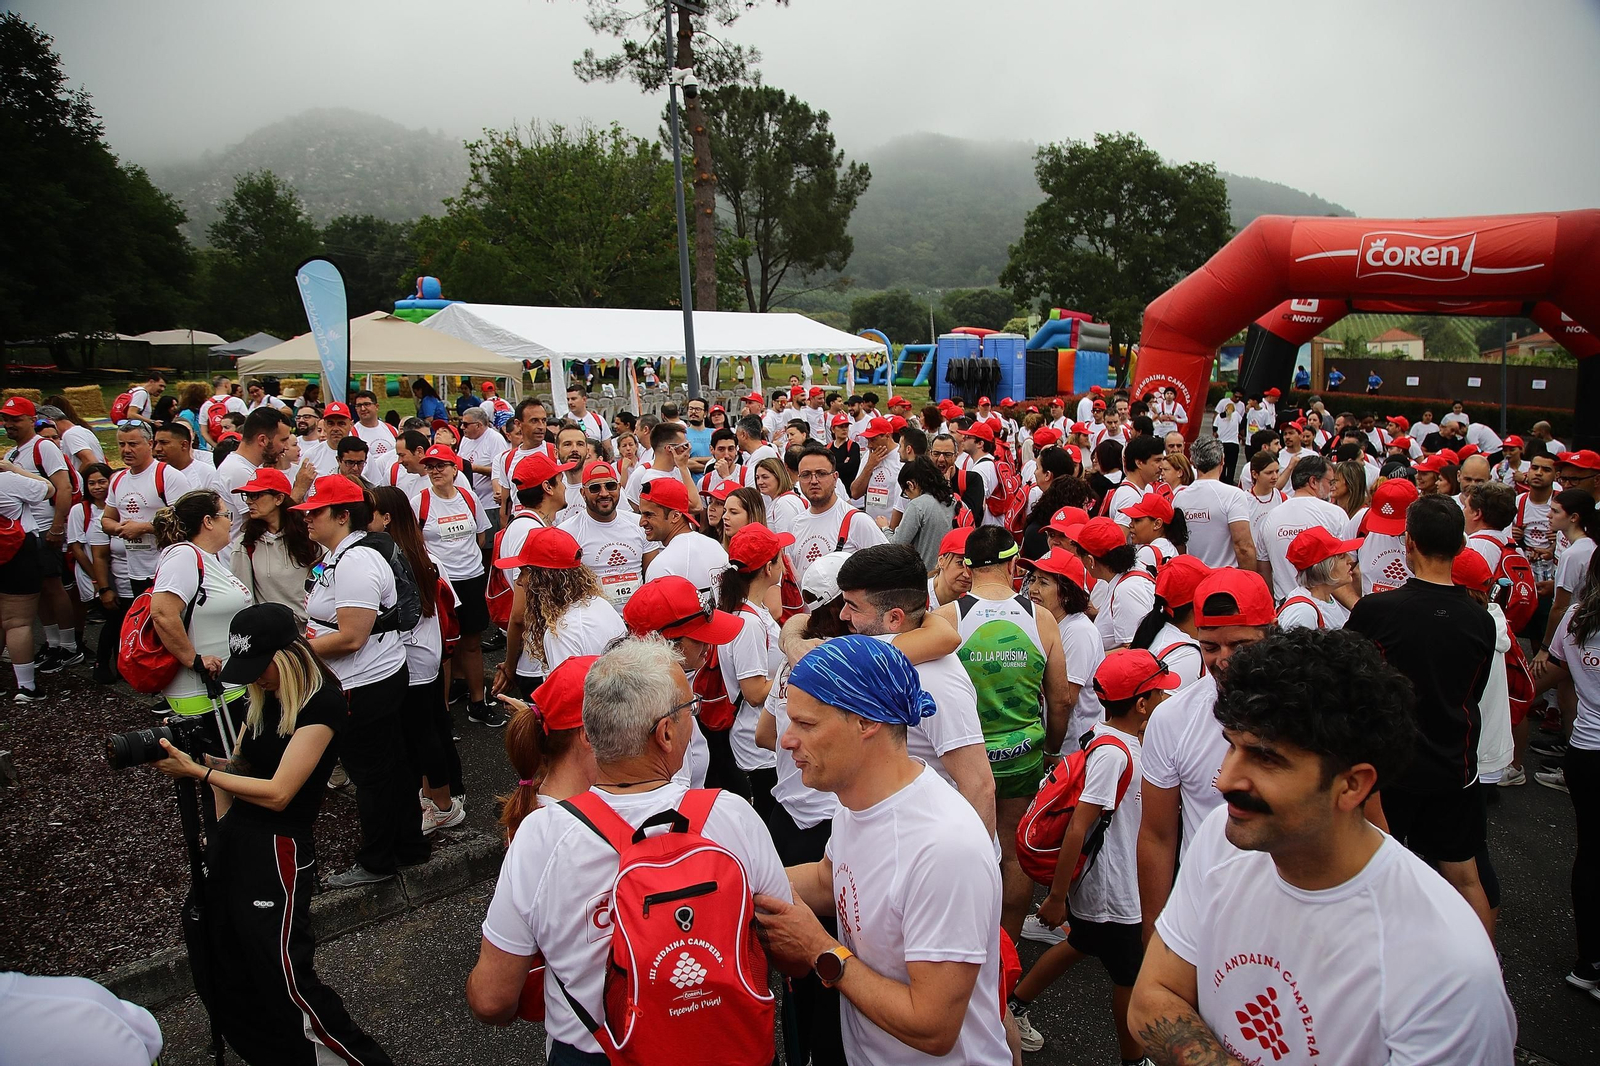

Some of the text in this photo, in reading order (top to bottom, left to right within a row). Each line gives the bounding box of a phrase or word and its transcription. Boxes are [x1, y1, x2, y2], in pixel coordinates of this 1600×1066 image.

[1139, 374, 1165, 390] ANDAINA
[1167, 376, 1191, 405] CAMPEIRA
[447, 524, 465, 533] 1110
[615, 587, 632, 596] 162
[969, 648, 1028, 662] C.D. LA PURÍSIMA
[653, 939, 685, 967] ANDAINA
[687, 938, 723, 964] CAMPEIRA
[669, 1002, 699, 1016] Facendo
[1224, 953, 1281, 973] ANDAINA
[1282, 970, 1320, 1057] CAMPEIRA
[1223, 1034, 1265, 1066] Facend
